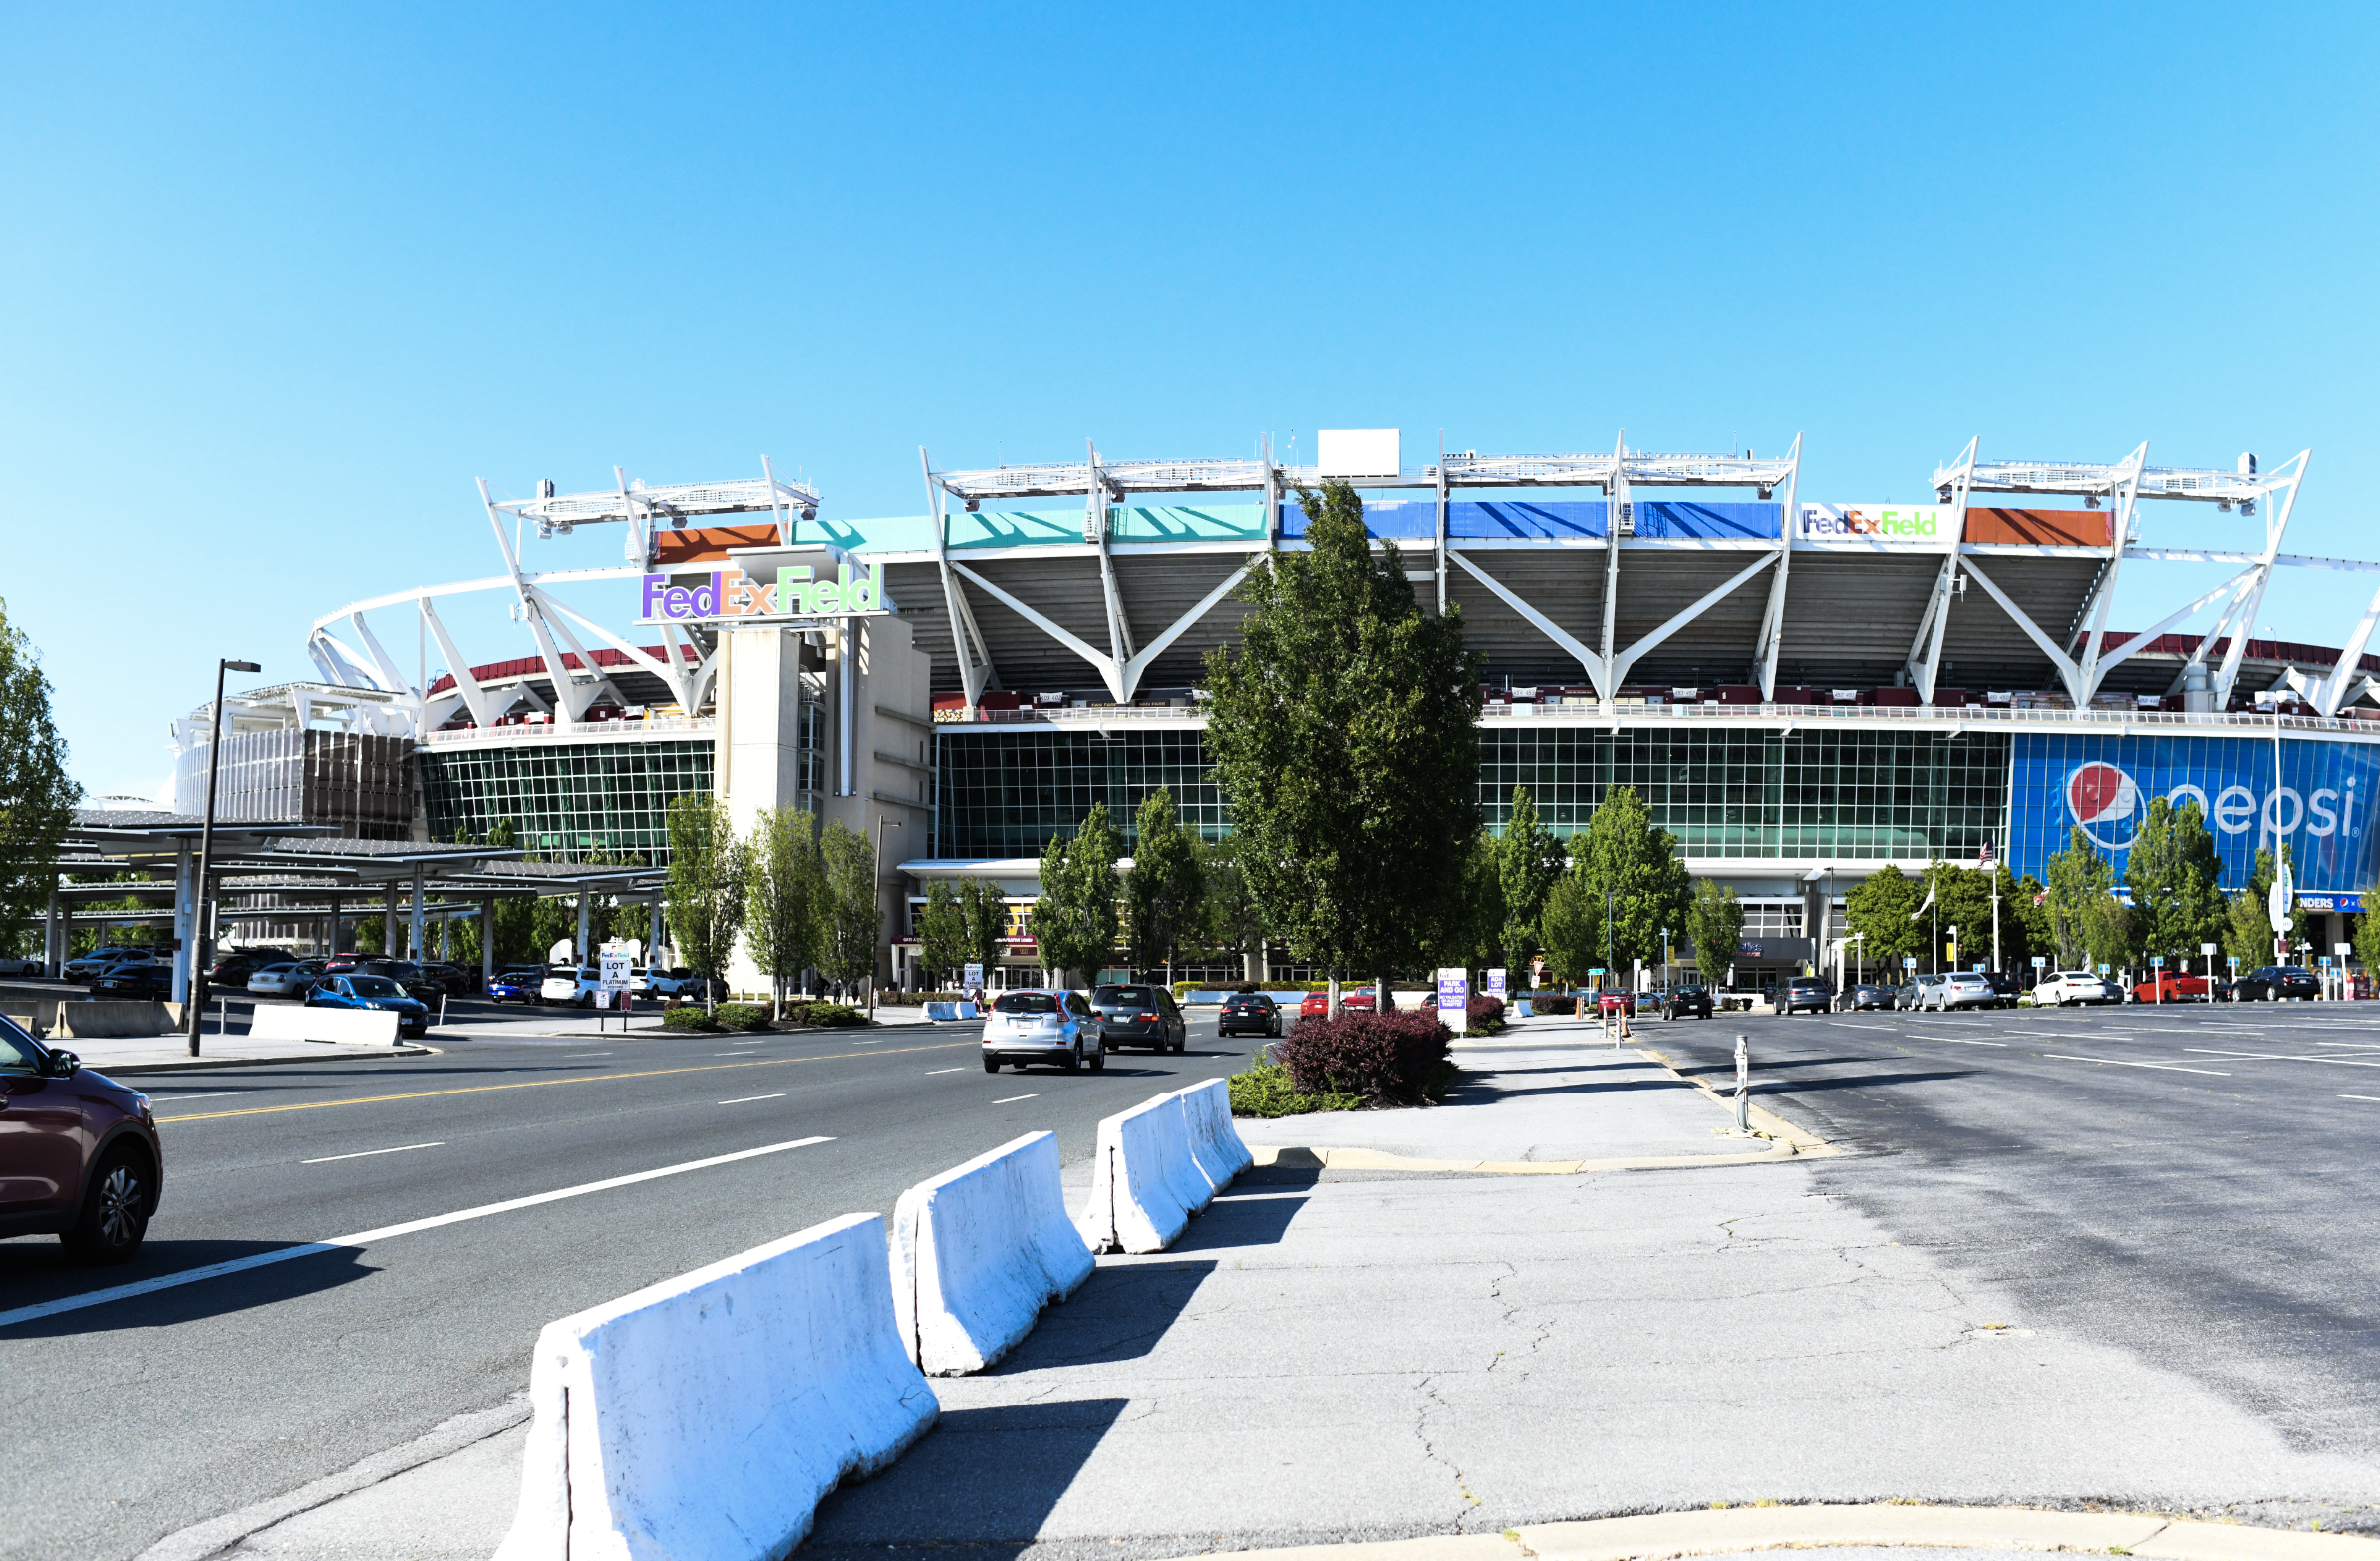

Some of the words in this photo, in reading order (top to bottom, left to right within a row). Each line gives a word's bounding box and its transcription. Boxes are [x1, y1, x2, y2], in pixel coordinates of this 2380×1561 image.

[1803, 509, 1936, 536] FedExField
[642, 564, 884, 618] FedExField
[2300, 897, 2334, 909] NDERS
